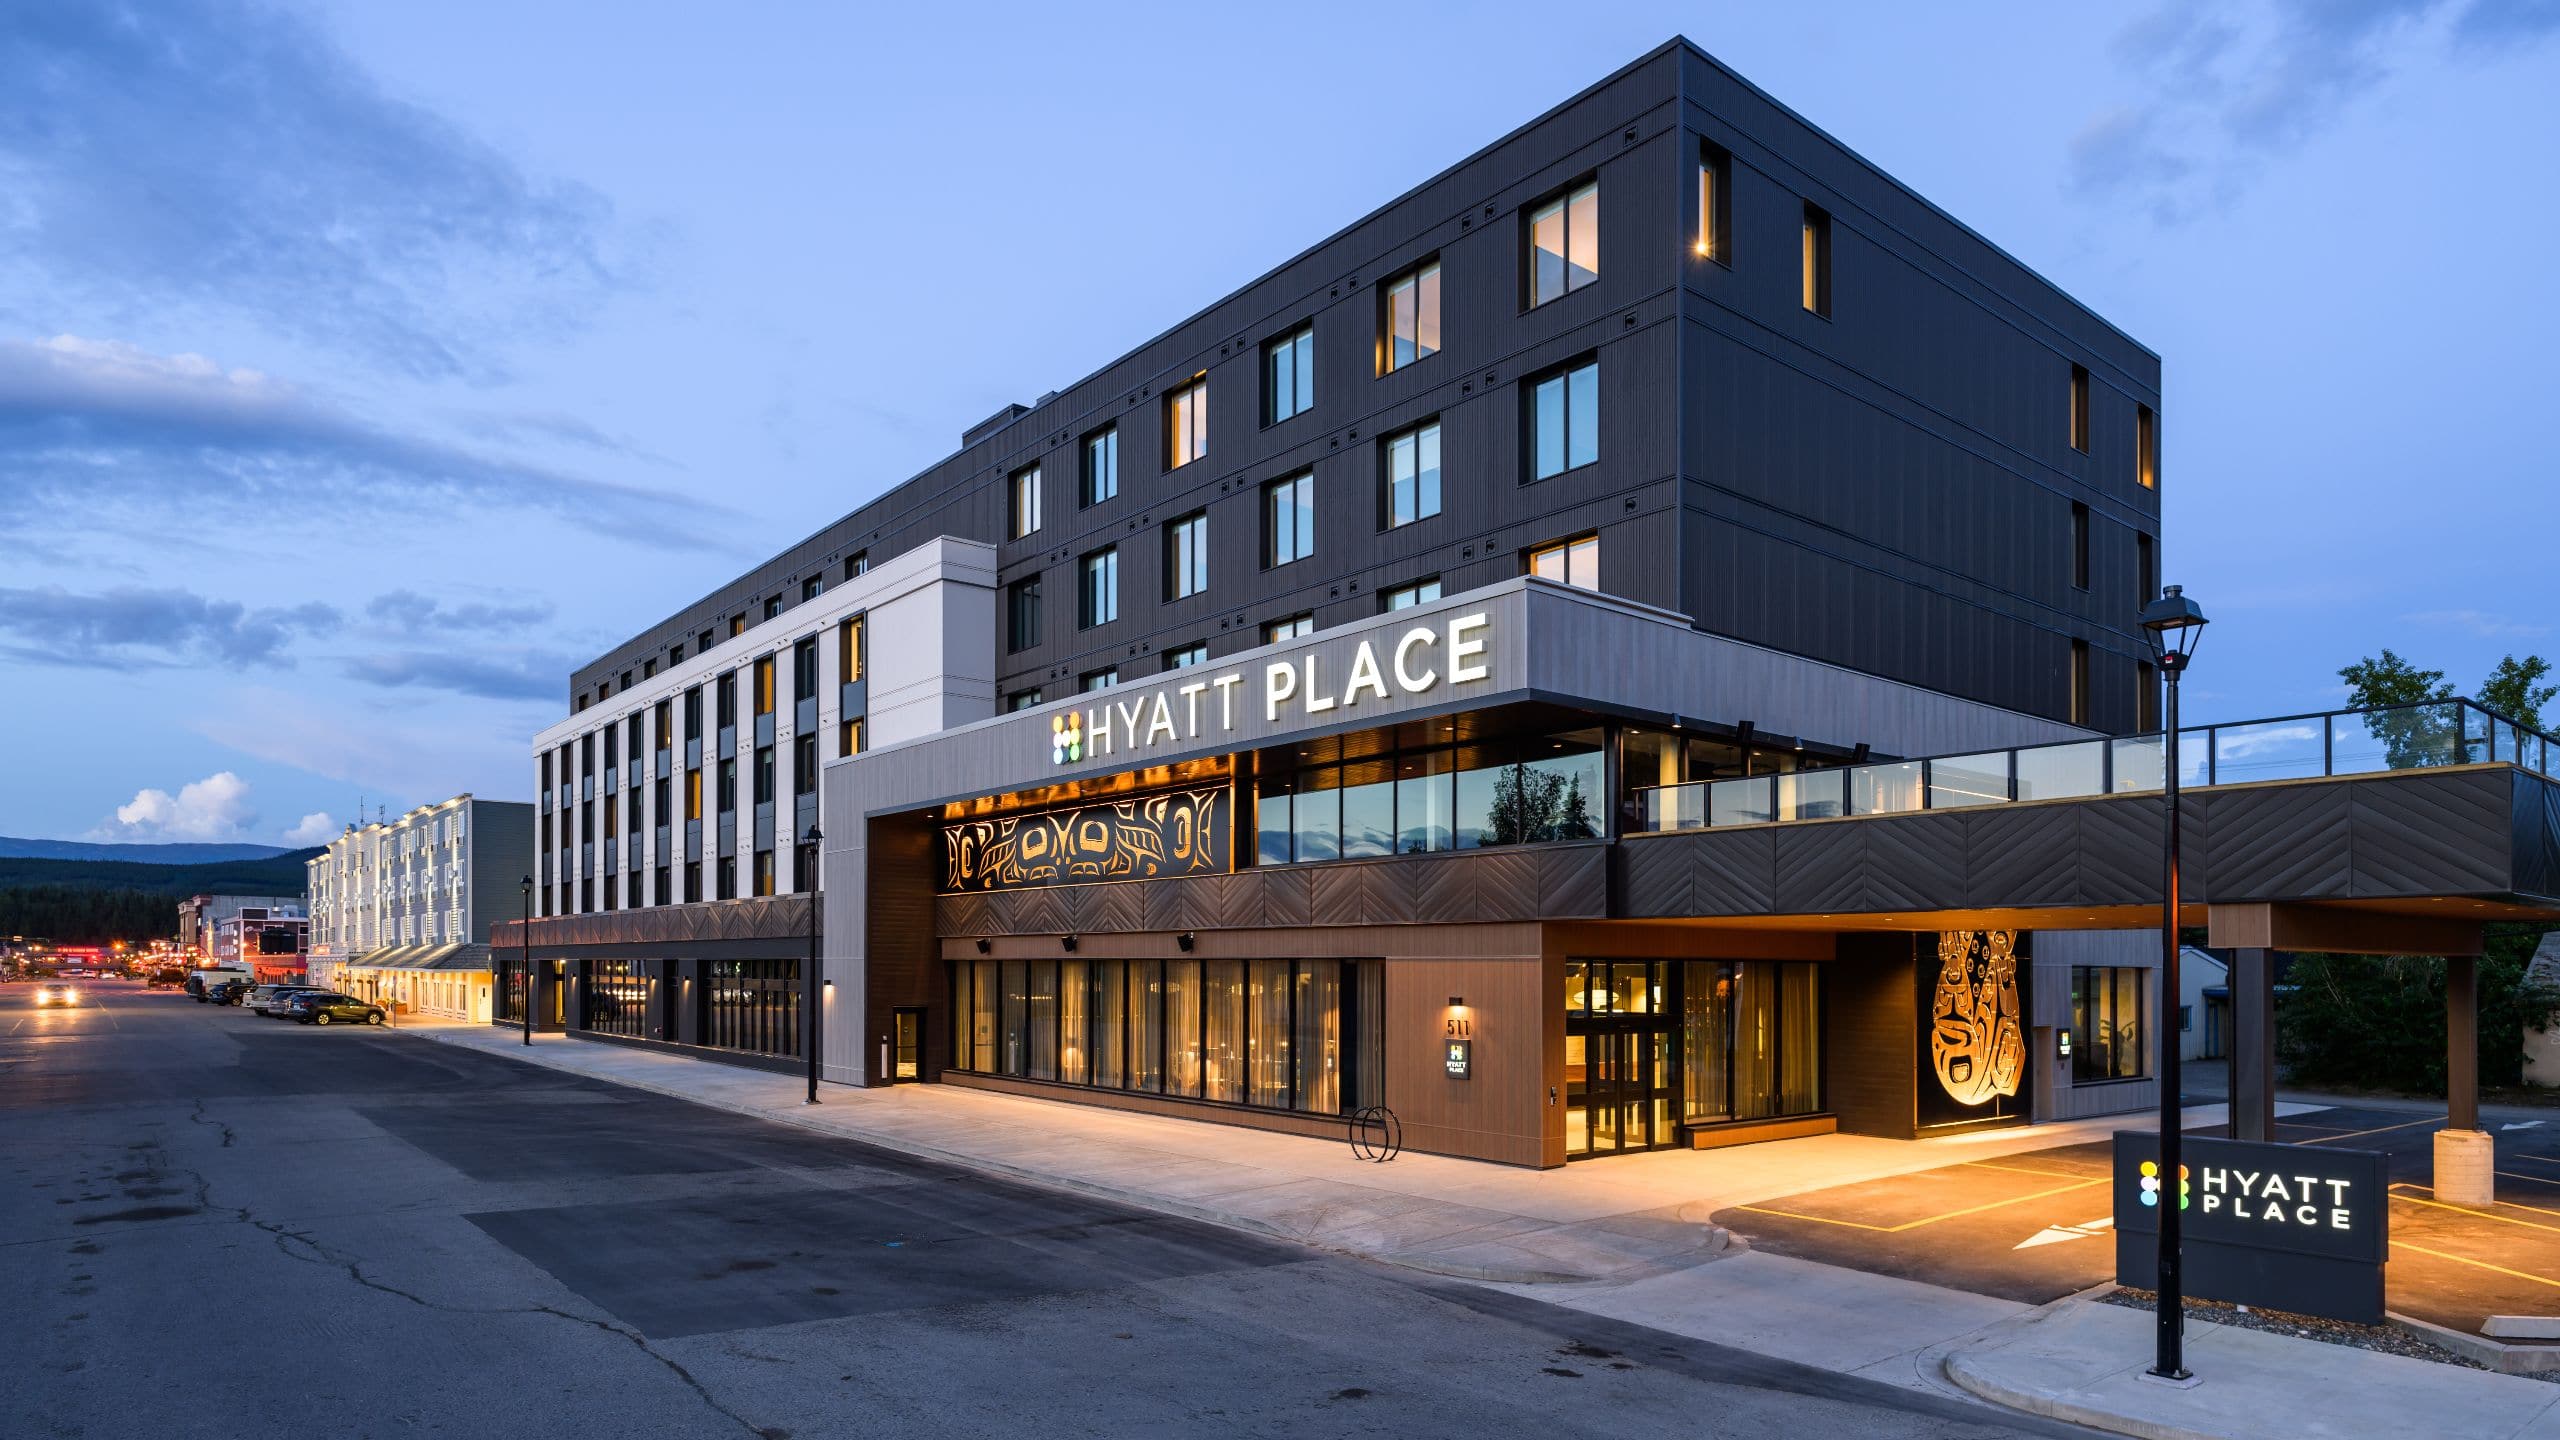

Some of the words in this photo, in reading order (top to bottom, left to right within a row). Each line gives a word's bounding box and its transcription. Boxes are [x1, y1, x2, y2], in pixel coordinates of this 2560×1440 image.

[1088, 673, 1245, 758] HYATT
[1265, 611, 1491, 722] PLACE
[1447, 1019, 1470, 1036] 511
[2203, 1167, 2351, 1206] HYATT
[2203, 1194, 2351, 1230] PLACE
